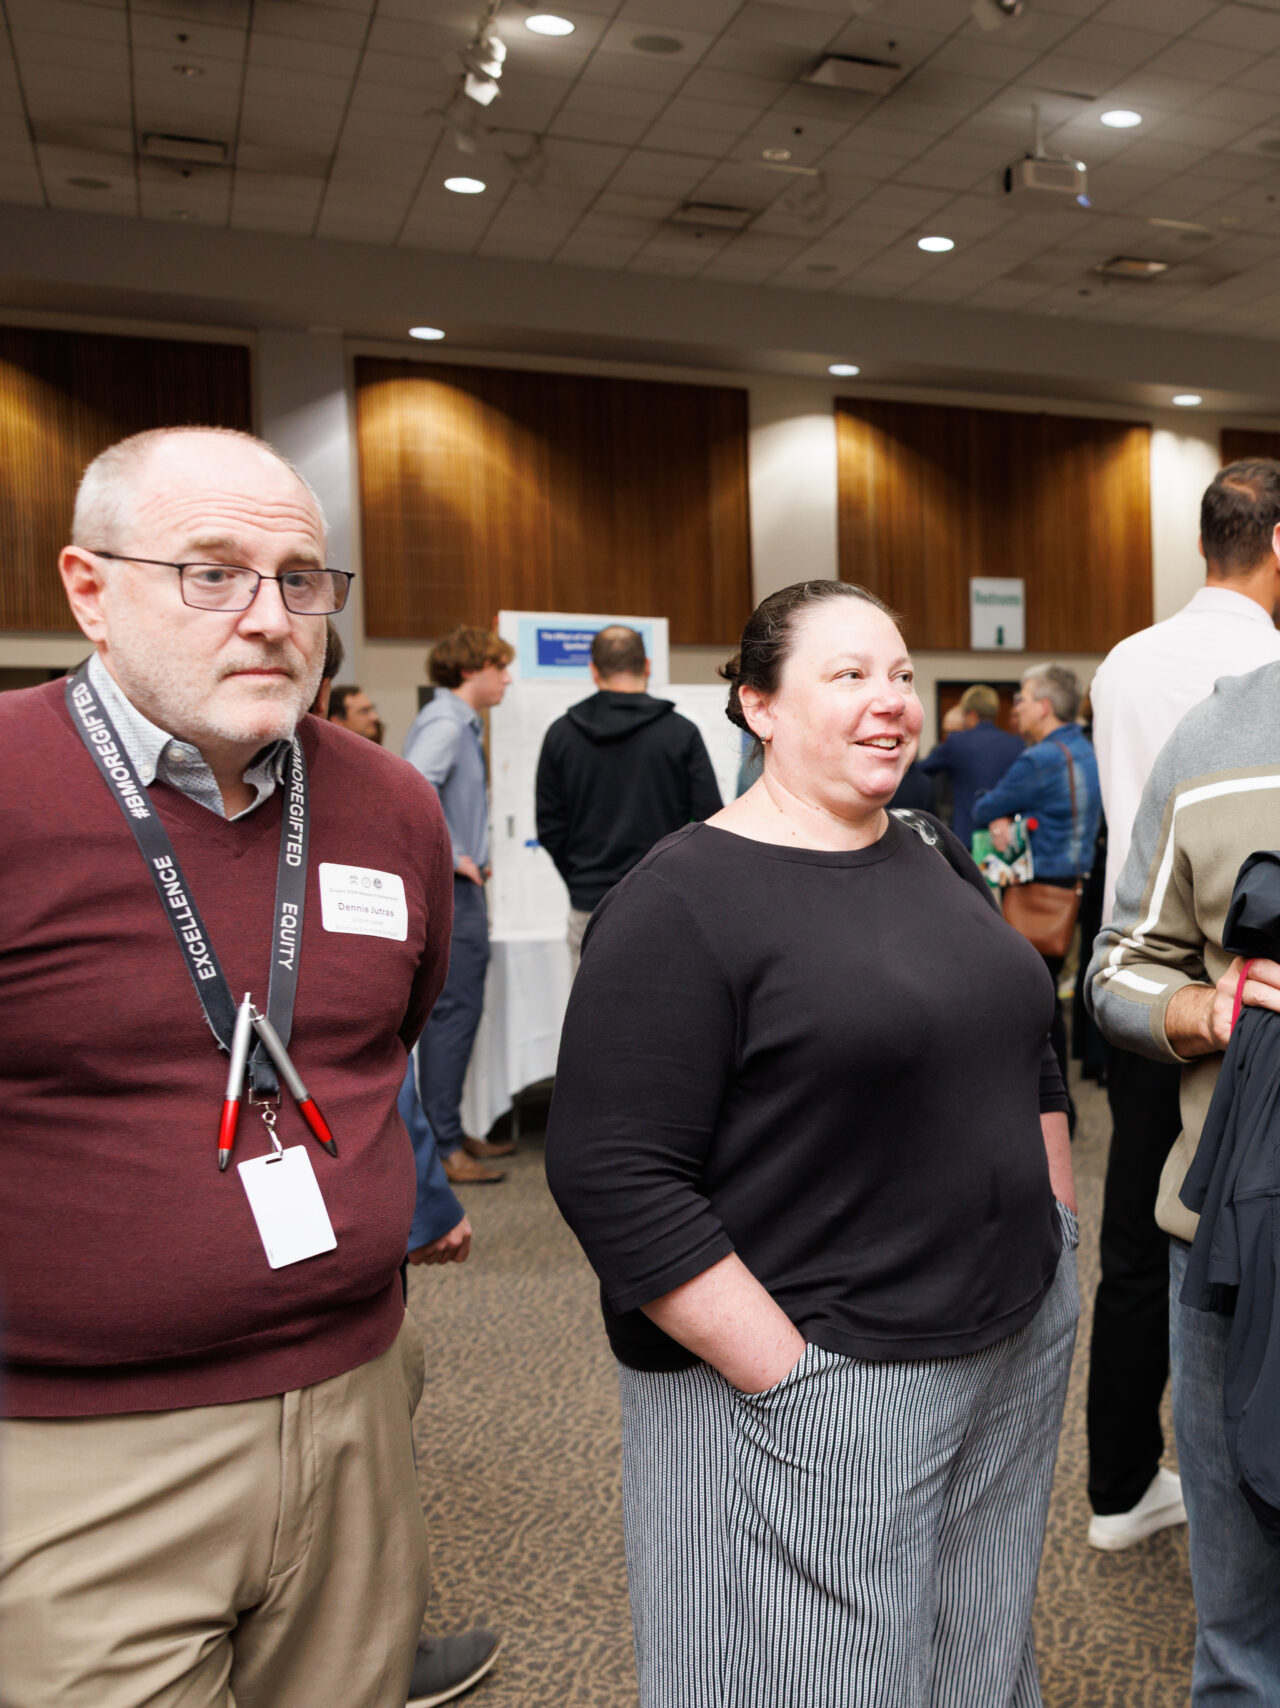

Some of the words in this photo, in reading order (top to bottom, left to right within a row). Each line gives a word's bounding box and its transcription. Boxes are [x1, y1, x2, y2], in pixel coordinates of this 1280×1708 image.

[72, 682, 151, 819] #BMOREGIFTED
[153, 855, 217, 981] EXCELLENCE
[278, 902, 298, 971] EQUITY
[338, 902, 370, 914] Dennis
